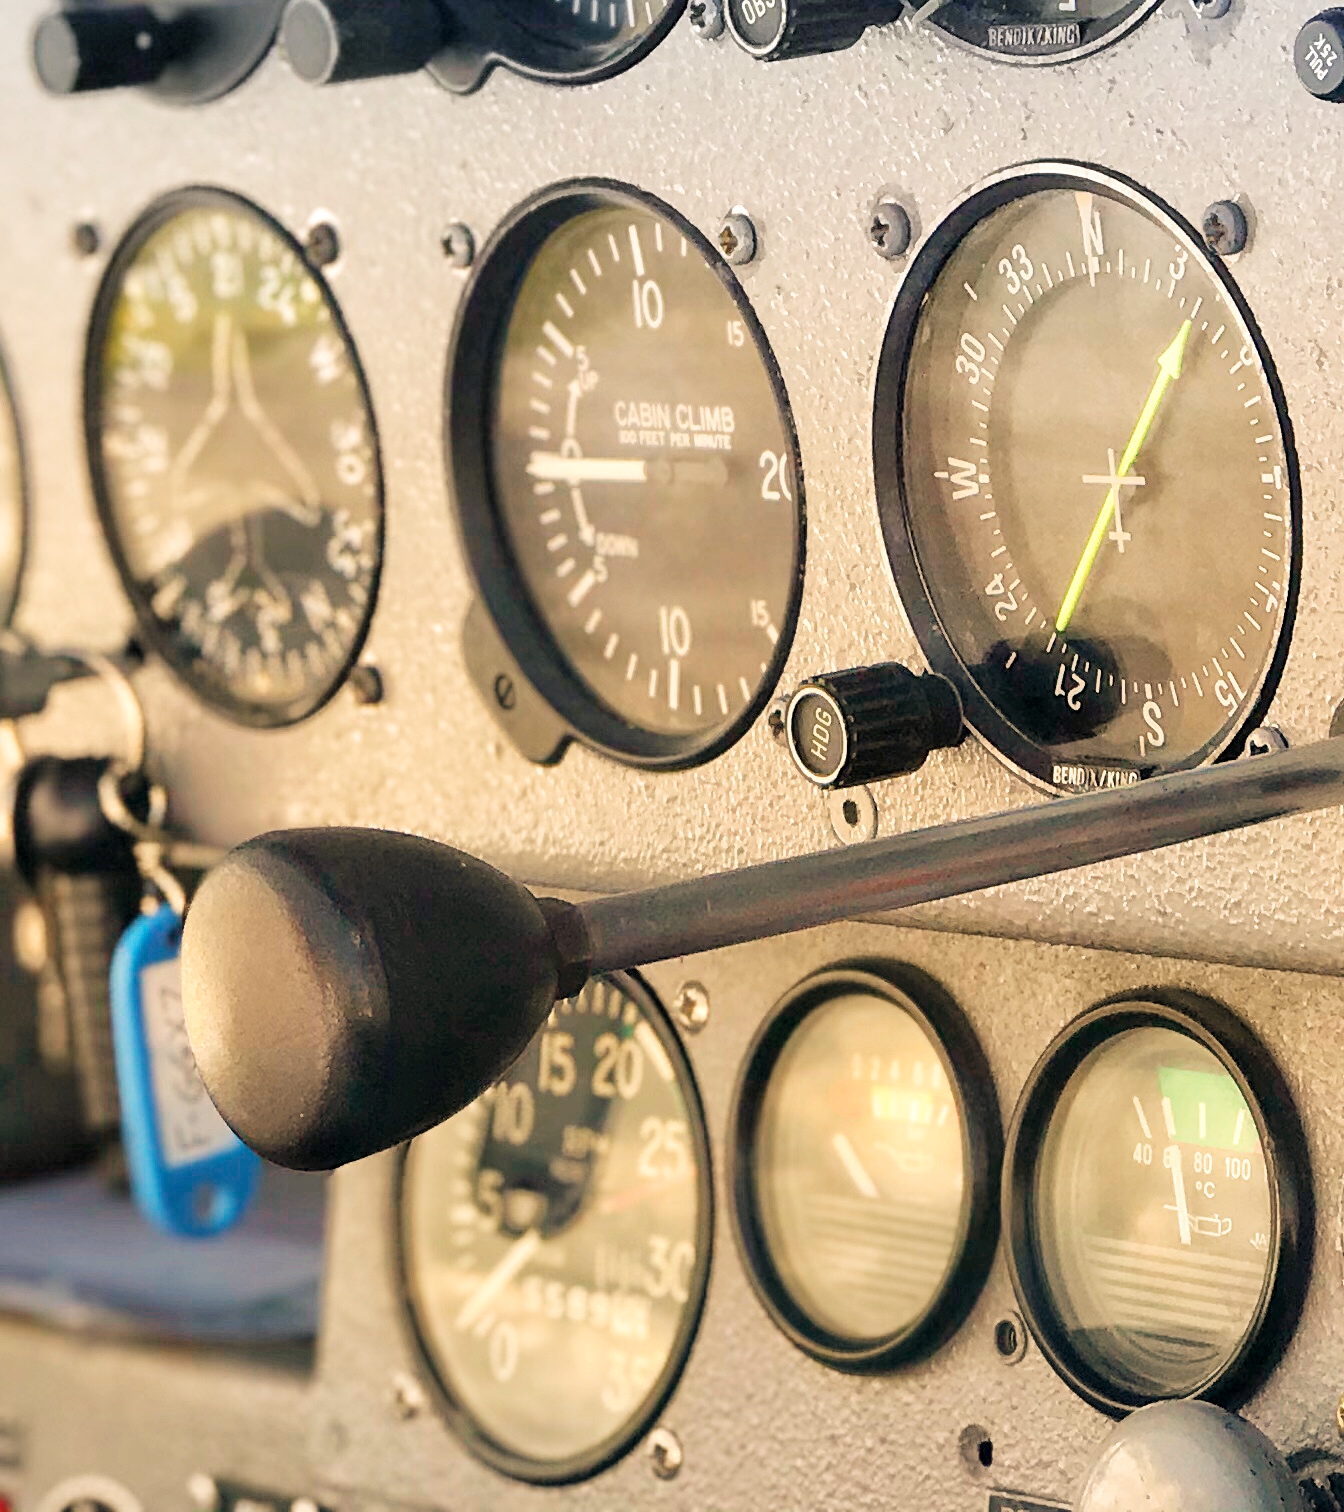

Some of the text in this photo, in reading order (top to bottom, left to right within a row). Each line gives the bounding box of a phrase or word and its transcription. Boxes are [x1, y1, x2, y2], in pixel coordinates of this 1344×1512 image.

[633, 280, 664, 329] 10
[615, 401, 734, 432] CABIN CLIMB
[811, 709, 833, 760] HDG
[539, 1033, 576, 1097] 15
[592, 1032, 644, 1099] 20
